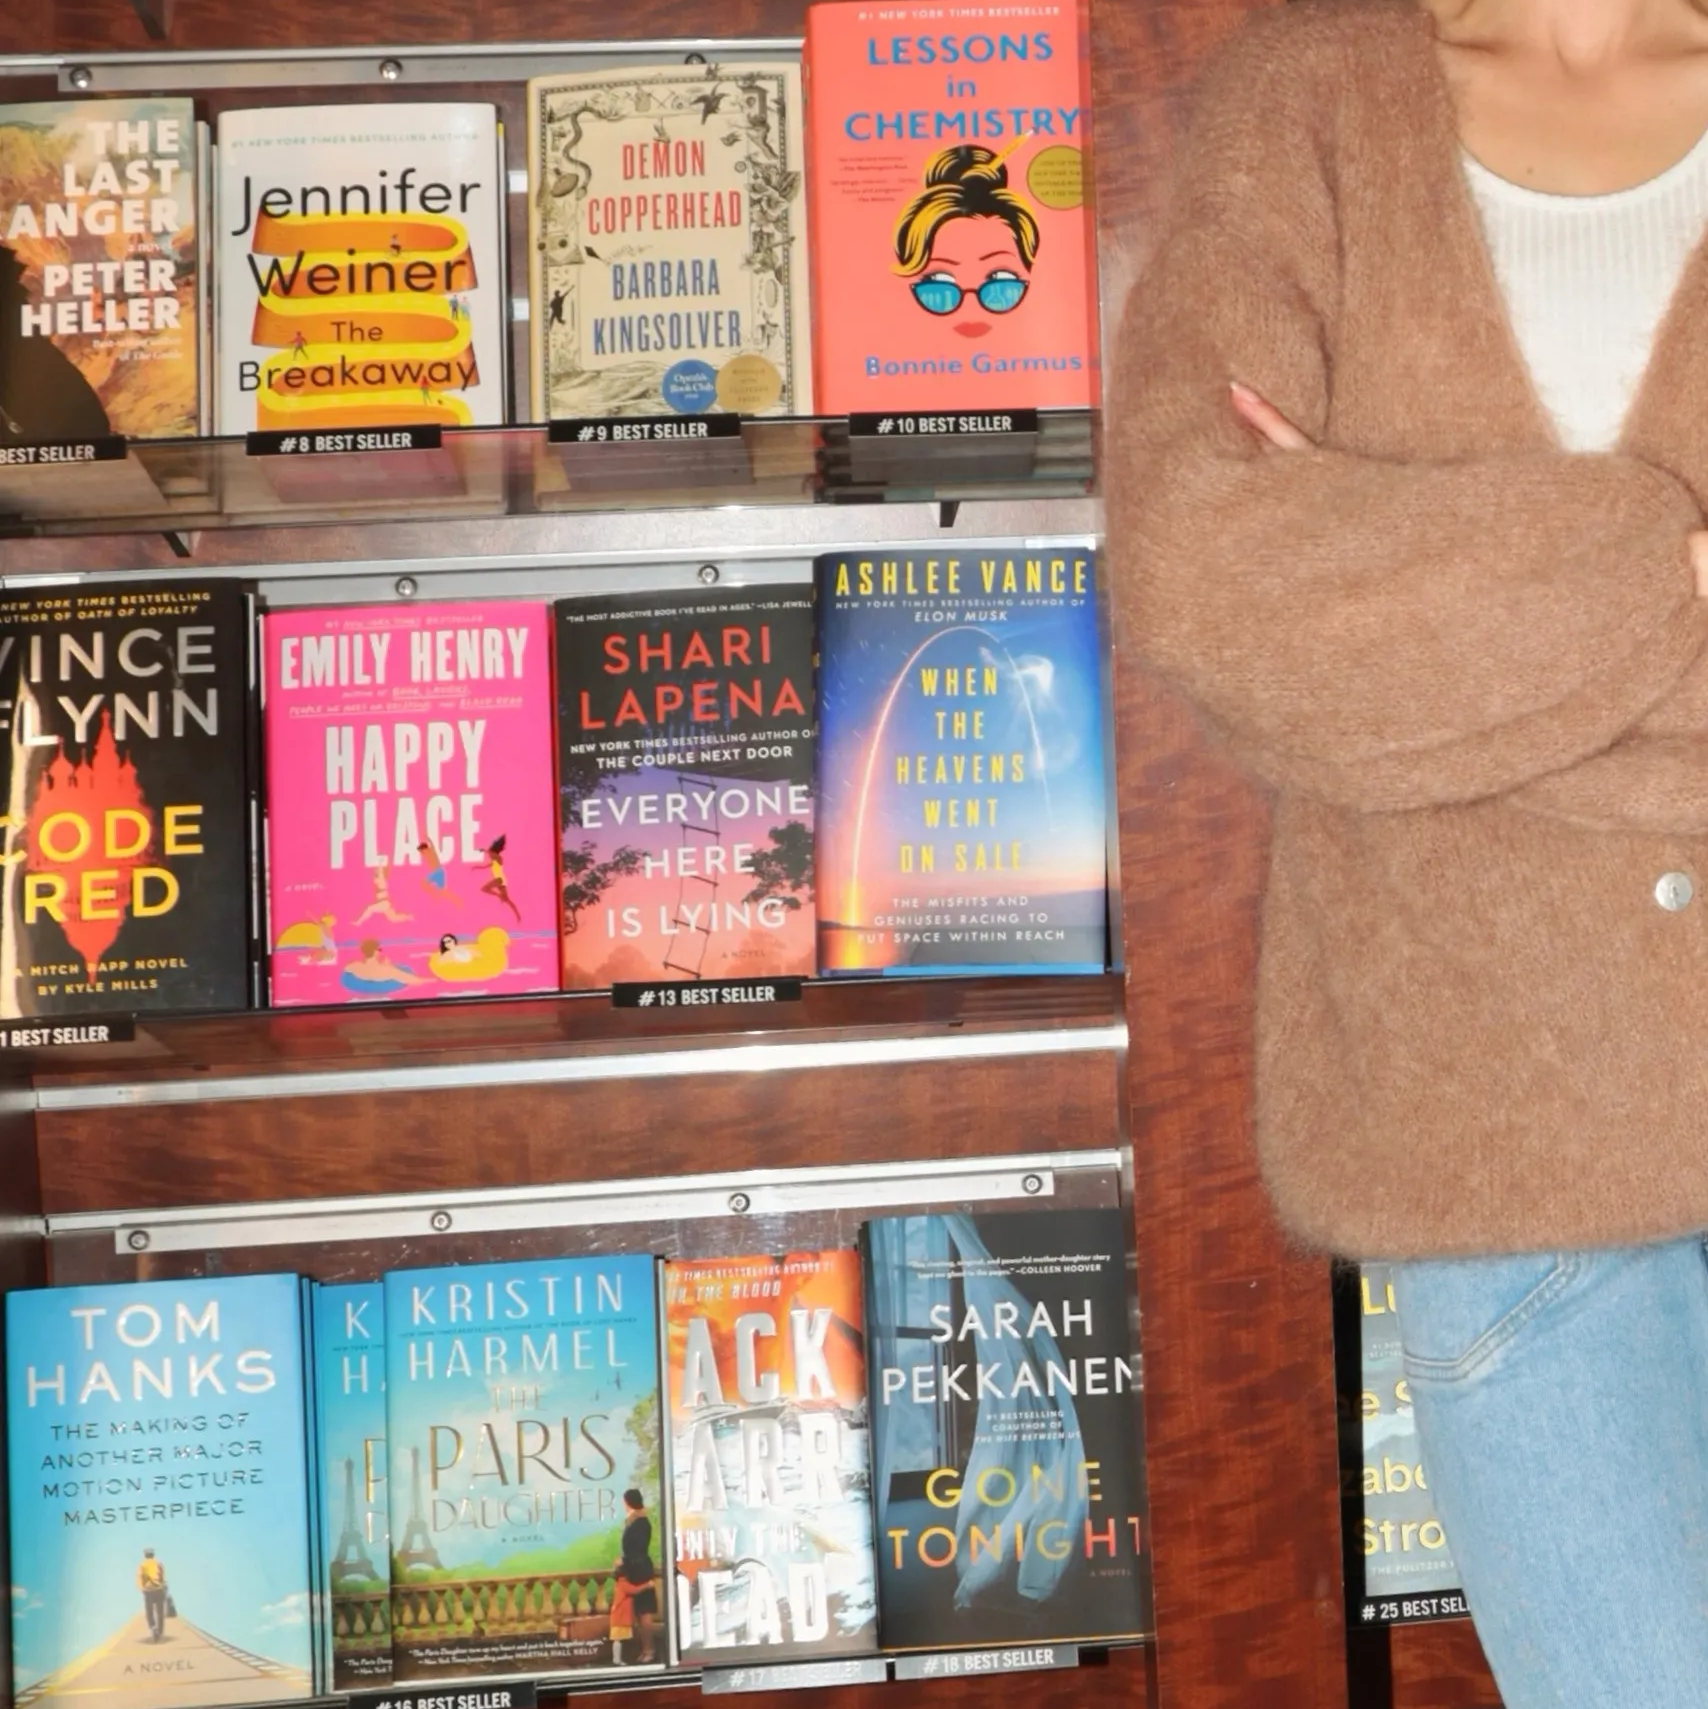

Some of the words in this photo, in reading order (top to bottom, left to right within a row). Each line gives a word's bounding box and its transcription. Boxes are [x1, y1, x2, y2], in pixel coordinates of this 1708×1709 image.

[867, 32, 1054, 66] LESSONS
[845, 108, 1080, 142] CHEMISTRY
[621, 141, 705, 181] DEMON
[232, 168, 481, 236] Jennifer
[588, 188, 742, 236] COPPERHEAD
[43, 259, 176, 297] PETER
[246, 249, 467, 298] Weiner
[20, 298, 182, 337] HELLER
[331, 322, 383, 342] The
[238, 357, 478, 392] Breakaway
[865, 355, 963, 378] Bonnie
[971, 352, 1082, 373] Garmus
[835, 560, 961, 597] ASHLEE
[981, 559, 1088, 595] VANCE
[915, 611, 959, 623] ELON
[964, 610, 1007, 622] MUSK
[281, 628, 391, 688] EMILY
[411, 627, 528, 683] HENRY
[604, 625, 771, 675] SHARI
[580, 678, 806, 730] LAPENA
[325, 719, 486, 794] HAPPY
[596, 756, 628, 769] THE
[632, 753, 697, 768] COUPLE
[700, 748, 741, 763] NEXT
[746, 745, 793, 760] DOOR
[581, 785, 811, 828] EVERYONE
[330, 794, 485, 870] PLACE
[38, 984, 59, 995] BY
[65, 982, 106, 993] KYLE
[111, 979, 158, 991] MILLS
[411, 1274, 623, 1325] KRISTIN
[71, 1299, 221, 1351] TOM
[930, 1299, 1093, 1345] SARAH
[409, 1328, 628, 1381] HARMEL
[26, 1350, 276, 1408] HANKS
[64, 1498, 245, 1526] MASTERPIECE
